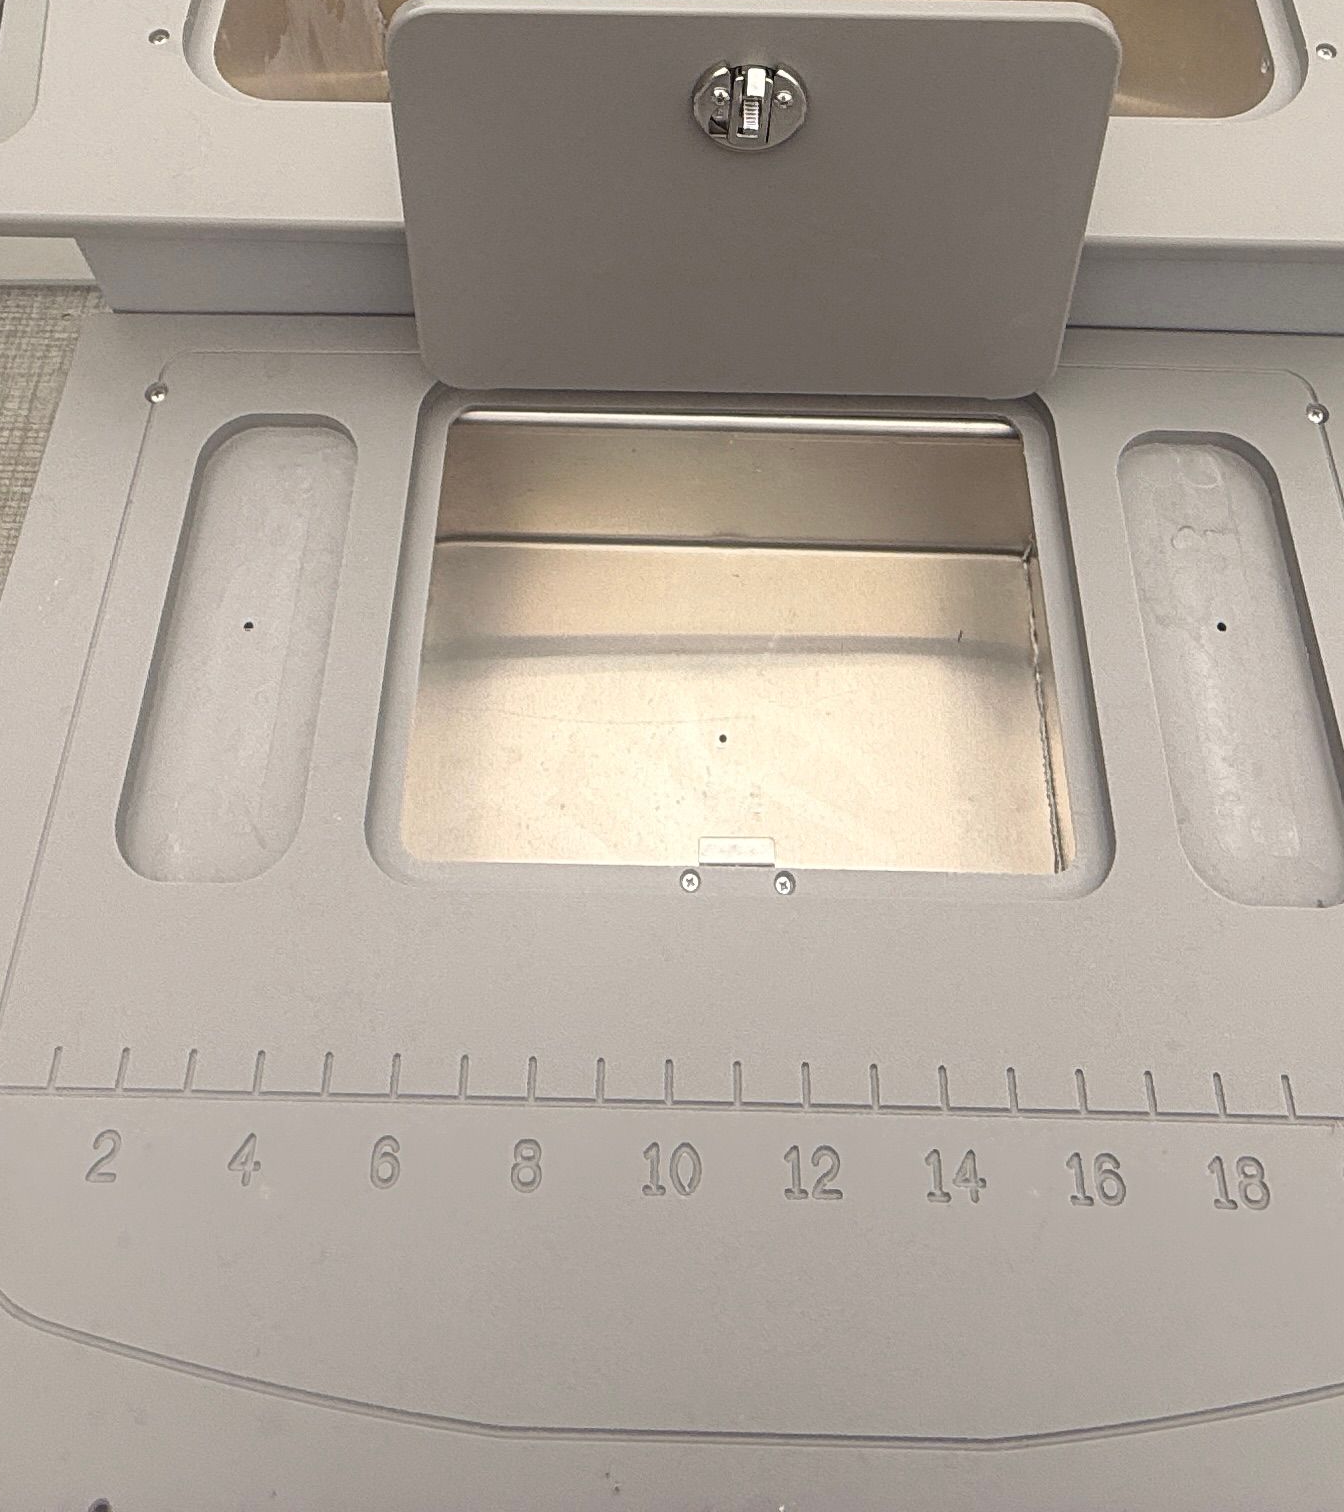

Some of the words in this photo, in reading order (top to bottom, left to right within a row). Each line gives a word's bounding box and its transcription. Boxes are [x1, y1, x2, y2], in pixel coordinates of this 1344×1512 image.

[84, 1129, 123, 1184] 2
[227, 1132, 262, 1187] 4
[369, 1134, 402, 1190] 6
[510, 1138, 543, 1193] 8
[641, 1141, 703, 1197] 10
[782, 1144, 844, 1201] 12
[923, 1148, 987, 1204] 14
[1065, 1151, 1127, 1207] 16
[1207, 1155, 1271, 1211] 18
